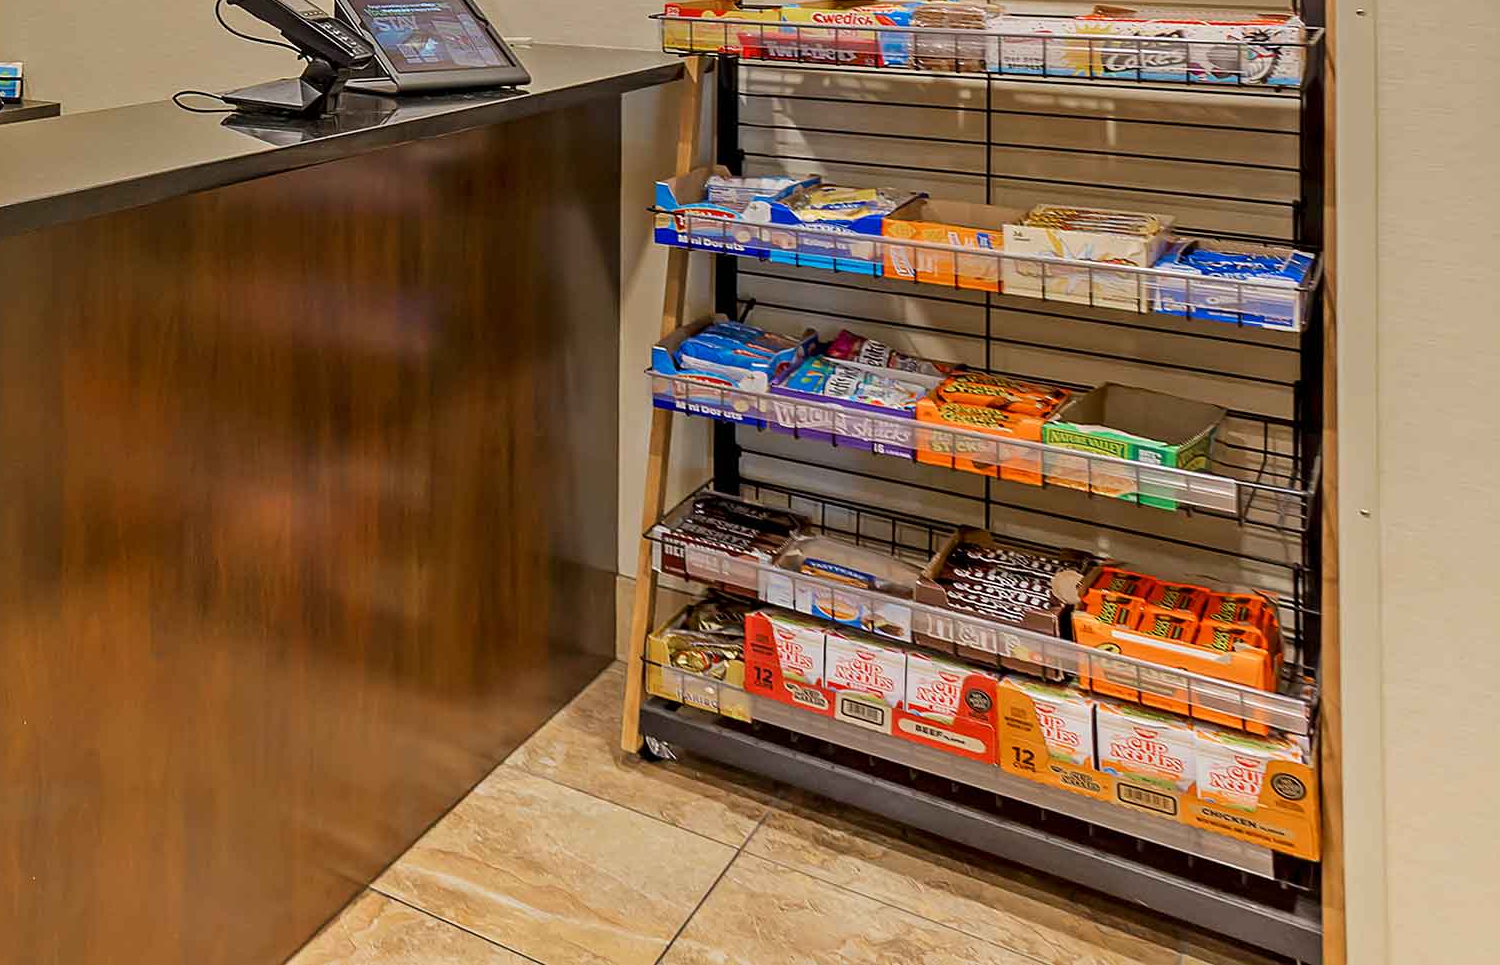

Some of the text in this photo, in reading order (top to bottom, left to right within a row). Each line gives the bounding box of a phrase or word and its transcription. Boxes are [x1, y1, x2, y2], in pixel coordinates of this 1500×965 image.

[812, 13, 874, 26] Swedish
[677, 234, 702, 246] Mni
[675, 400, 700, 412] Mni
[754, 665, 774, 685] 12
[836, 664, 894, 692] NOODLES
[850, 659, 884, 678] CUP
[916, 686, 959, 707] NOOD
[931, 682, 959, 700] CU
[915, 724, 943, 737] BEEF
[1011, 746, 1036, 766] 12
[1128, 737, 1169, 757] CUP
[1109, 742, 1186, 774] NOODLES
[1209, 770, 1262, 796] NOOD
[1226, 766, 1262, 786] CU
[1201, 807, 1257, 829] CHICKEN
